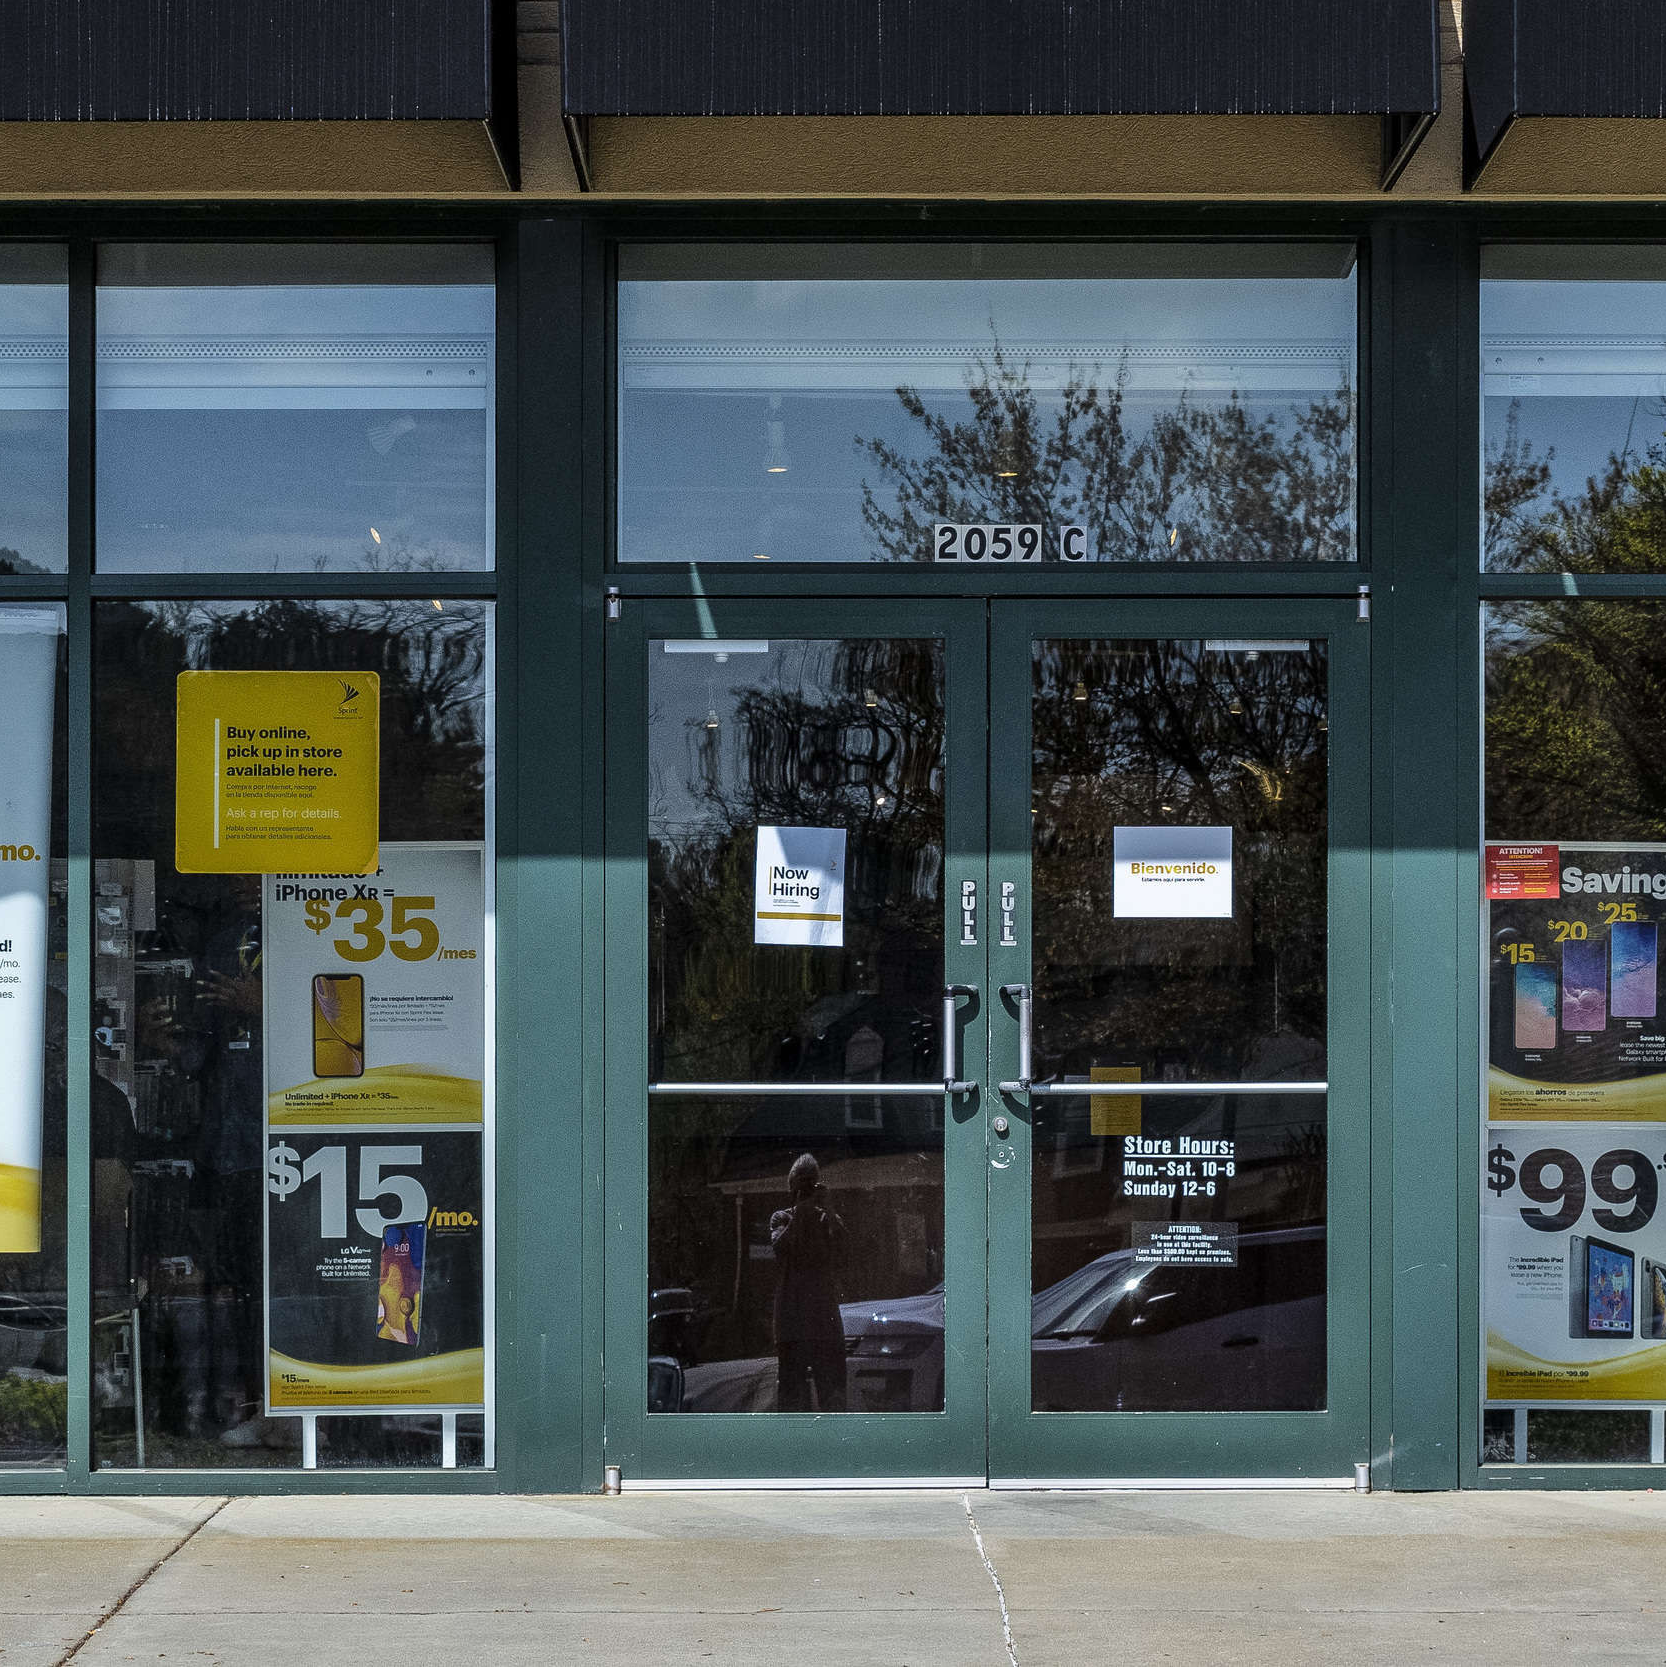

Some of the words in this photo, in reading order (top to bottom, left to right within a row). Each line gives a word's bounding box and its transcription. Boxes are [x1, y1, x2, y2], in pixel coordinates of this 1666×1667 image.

[938, 526, 1039, 560] 2059
[1063, 527, 1085, 560] C
[227, 726, 256, 741] Buy
[259, 726, 311, 740] online,
[226, 745, 259, 760] pick
[262, 748, 282, 760] up
[285, 745, 299, 758] in
[303, 746, 342, 758] store
[226, 763, 295, 777] available
[298, 764, 337, 777] here.
[226, 807, 247, 819] Ask
[249, 809, 256, 819] a
[259, 809, 280, 820] rep
[282, 807, 297, 819] for
[300, 807, 341, 819] details.
[1499, 847, 1543, 855] ATTENTION!
[773, 866, 809, 880] Now
[1131, 862, 1219, 874] Bienvenido.
[276, 884, 348, 902] iPhone
[383, 888, 395, 897] =
[773, 883, 820, 900] Hiring
[962, 881, 976, 940] PULL
[1001, 882, 1015, 941] PULL
[1597, 902, 1637, 925] $25
[1547, 919, 1588, 943] $20
[1500, 943, 1535, 965] $15
[1124, 1135, 1172, 1154] Store
[1179, 1136, 1235, 1154] Hours:
[1124, 1161, 1196, 1176] Mon.-Sat.
[1201, 1161, 1235, 1177] 10-8
[1123, 1180, 1176, 1198] Sunday
[1182, 1181, 1216, 1196] 12-6
[1167, 1225, 1202, 1234] ATTENTION:
[395, 1244, 409, 1252] 9:00
